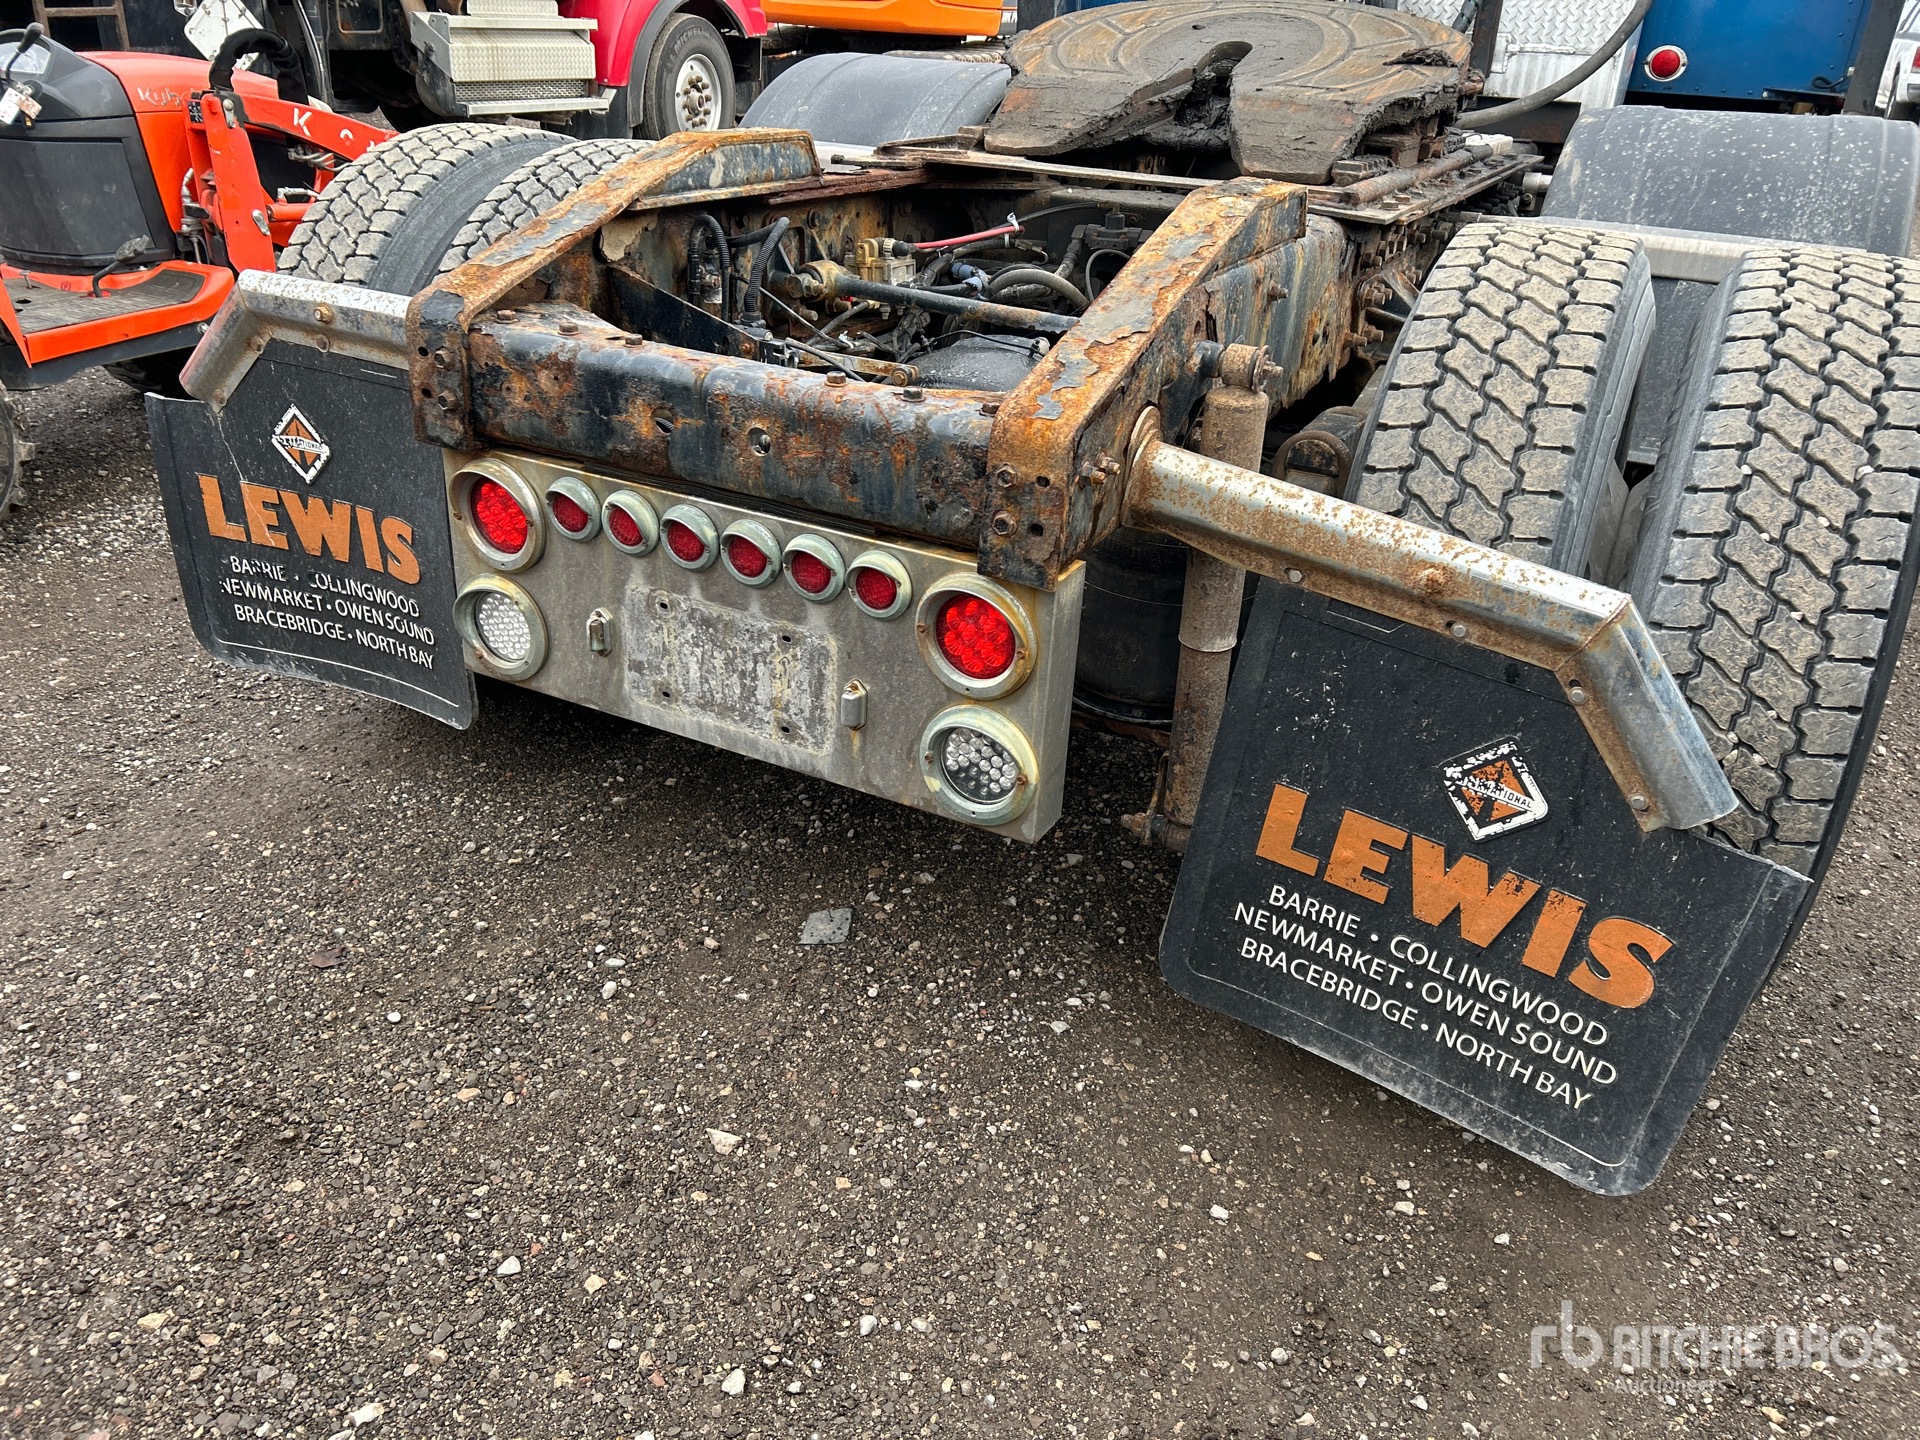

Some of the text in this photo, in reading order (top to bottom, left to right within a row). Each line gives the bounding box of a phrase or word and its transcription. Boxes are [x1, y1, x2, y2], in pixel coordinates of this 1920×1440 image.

[197, 473, 421, 585] LEWIS
[230, 555, 286, 581] BARRIE
[234, 604, 434, 670] BRACEBRIDGE NORTH BAY
[335, 599, 384, 627] OWEN
[385, 615, 434, 645] SOUND
[1255, 783, 1674, 1009] LEWIS
[1234, 902, 1618, 1087] NEWMARKET OWEN SOUND
[1240, 937, 1593, 1110] BRACEBRIDGE NORTH BAY
[1268, 885, 1608, 1047] BARRIE COLLINGWOOD
